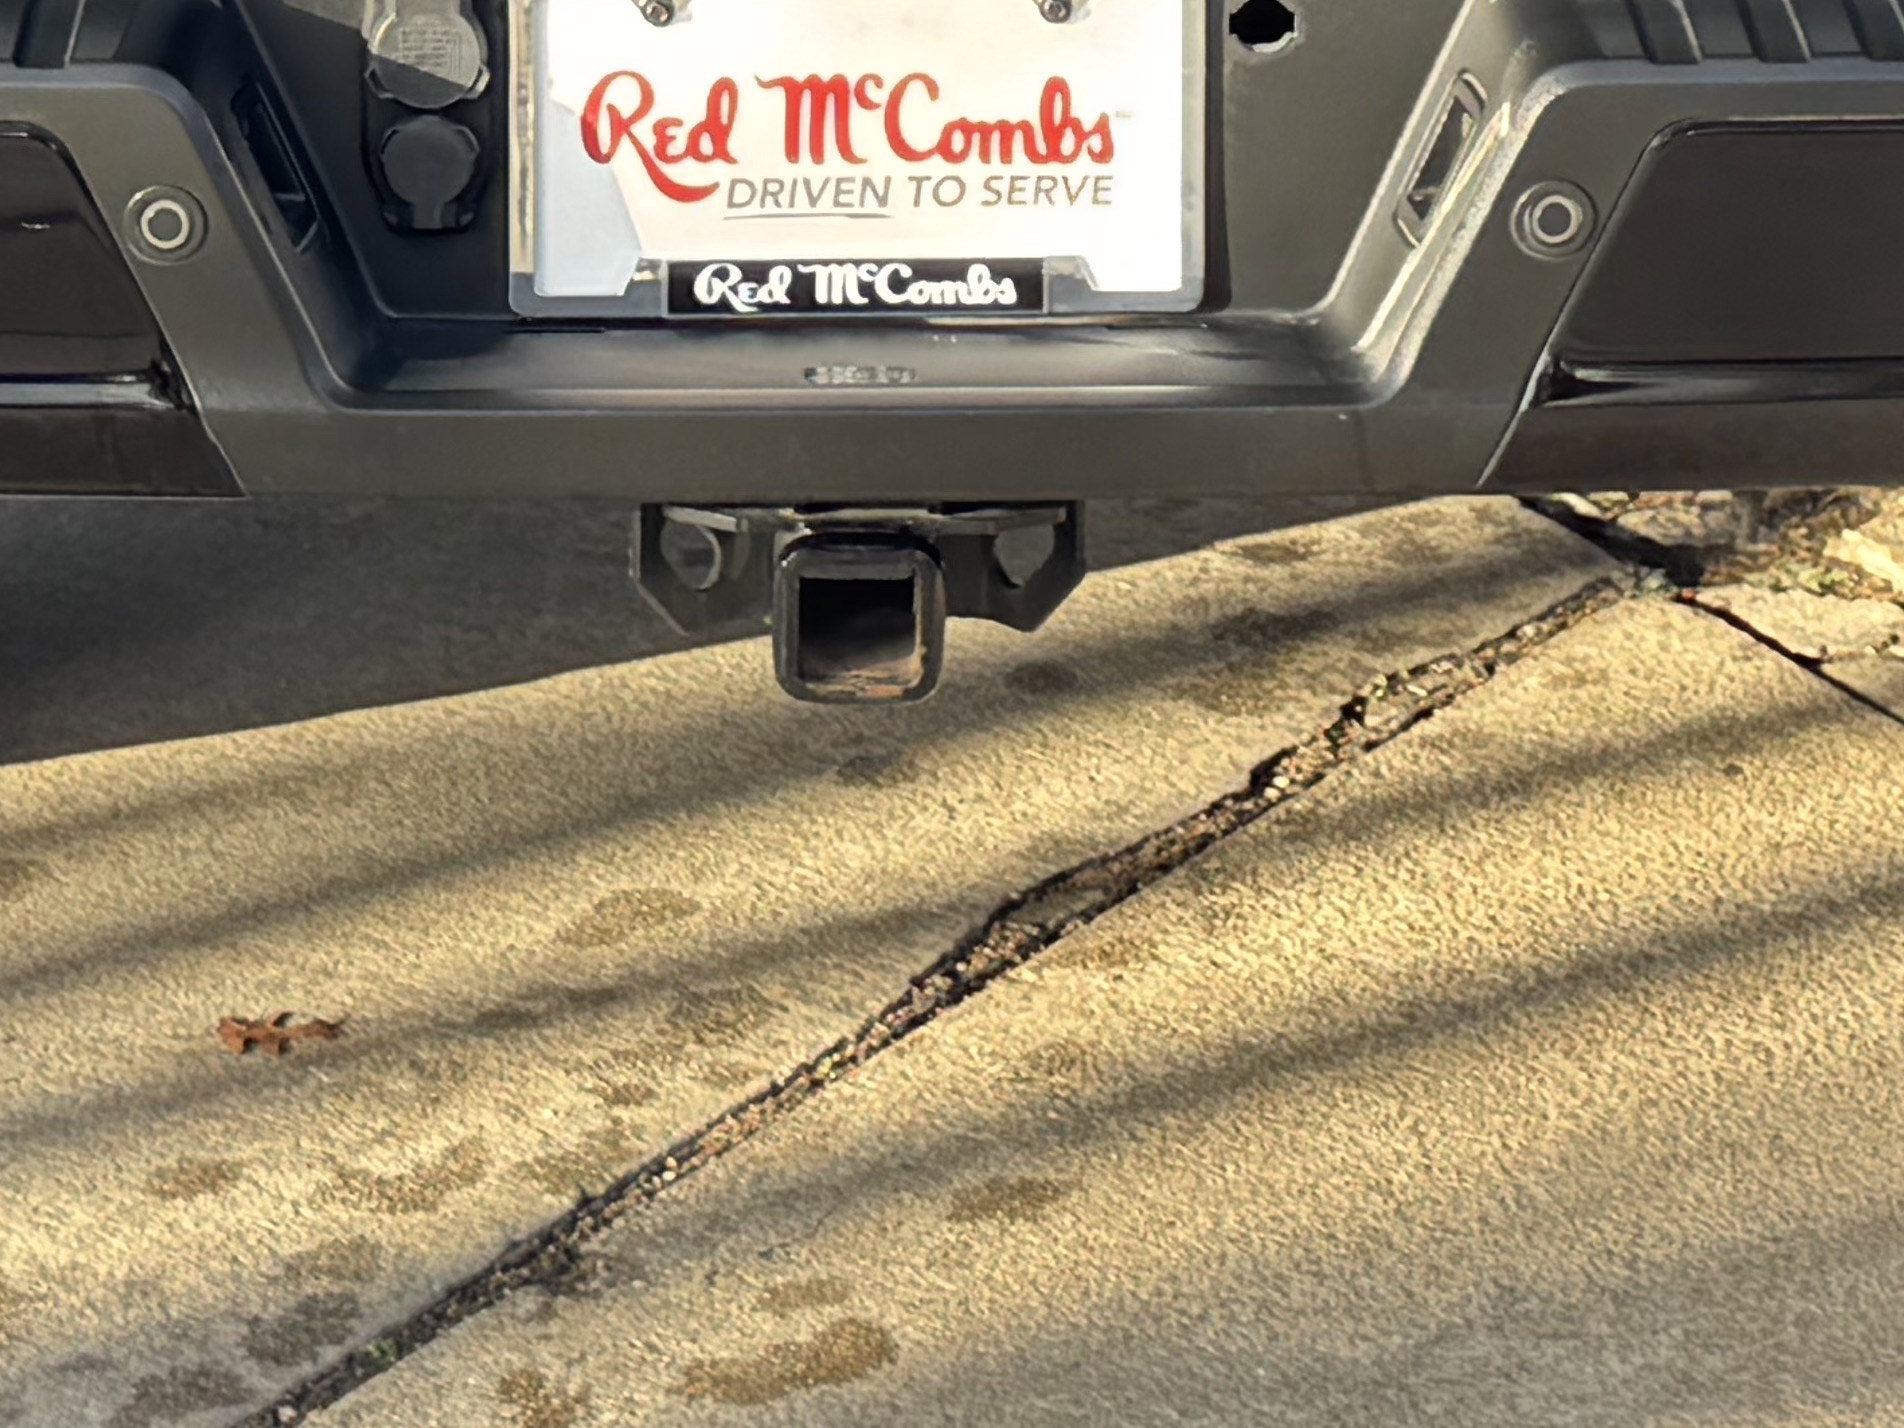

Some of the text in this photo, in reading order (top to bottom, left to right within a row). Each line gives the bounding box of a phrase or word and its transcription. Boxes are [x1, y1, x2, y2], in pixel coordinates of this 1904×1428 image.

[579, 69, 1115, 204] Red McCombs
[726, 175, 1115, 210] DRIVEN TO SERVE
[693, 262, 1018, 313] Red McCombs
